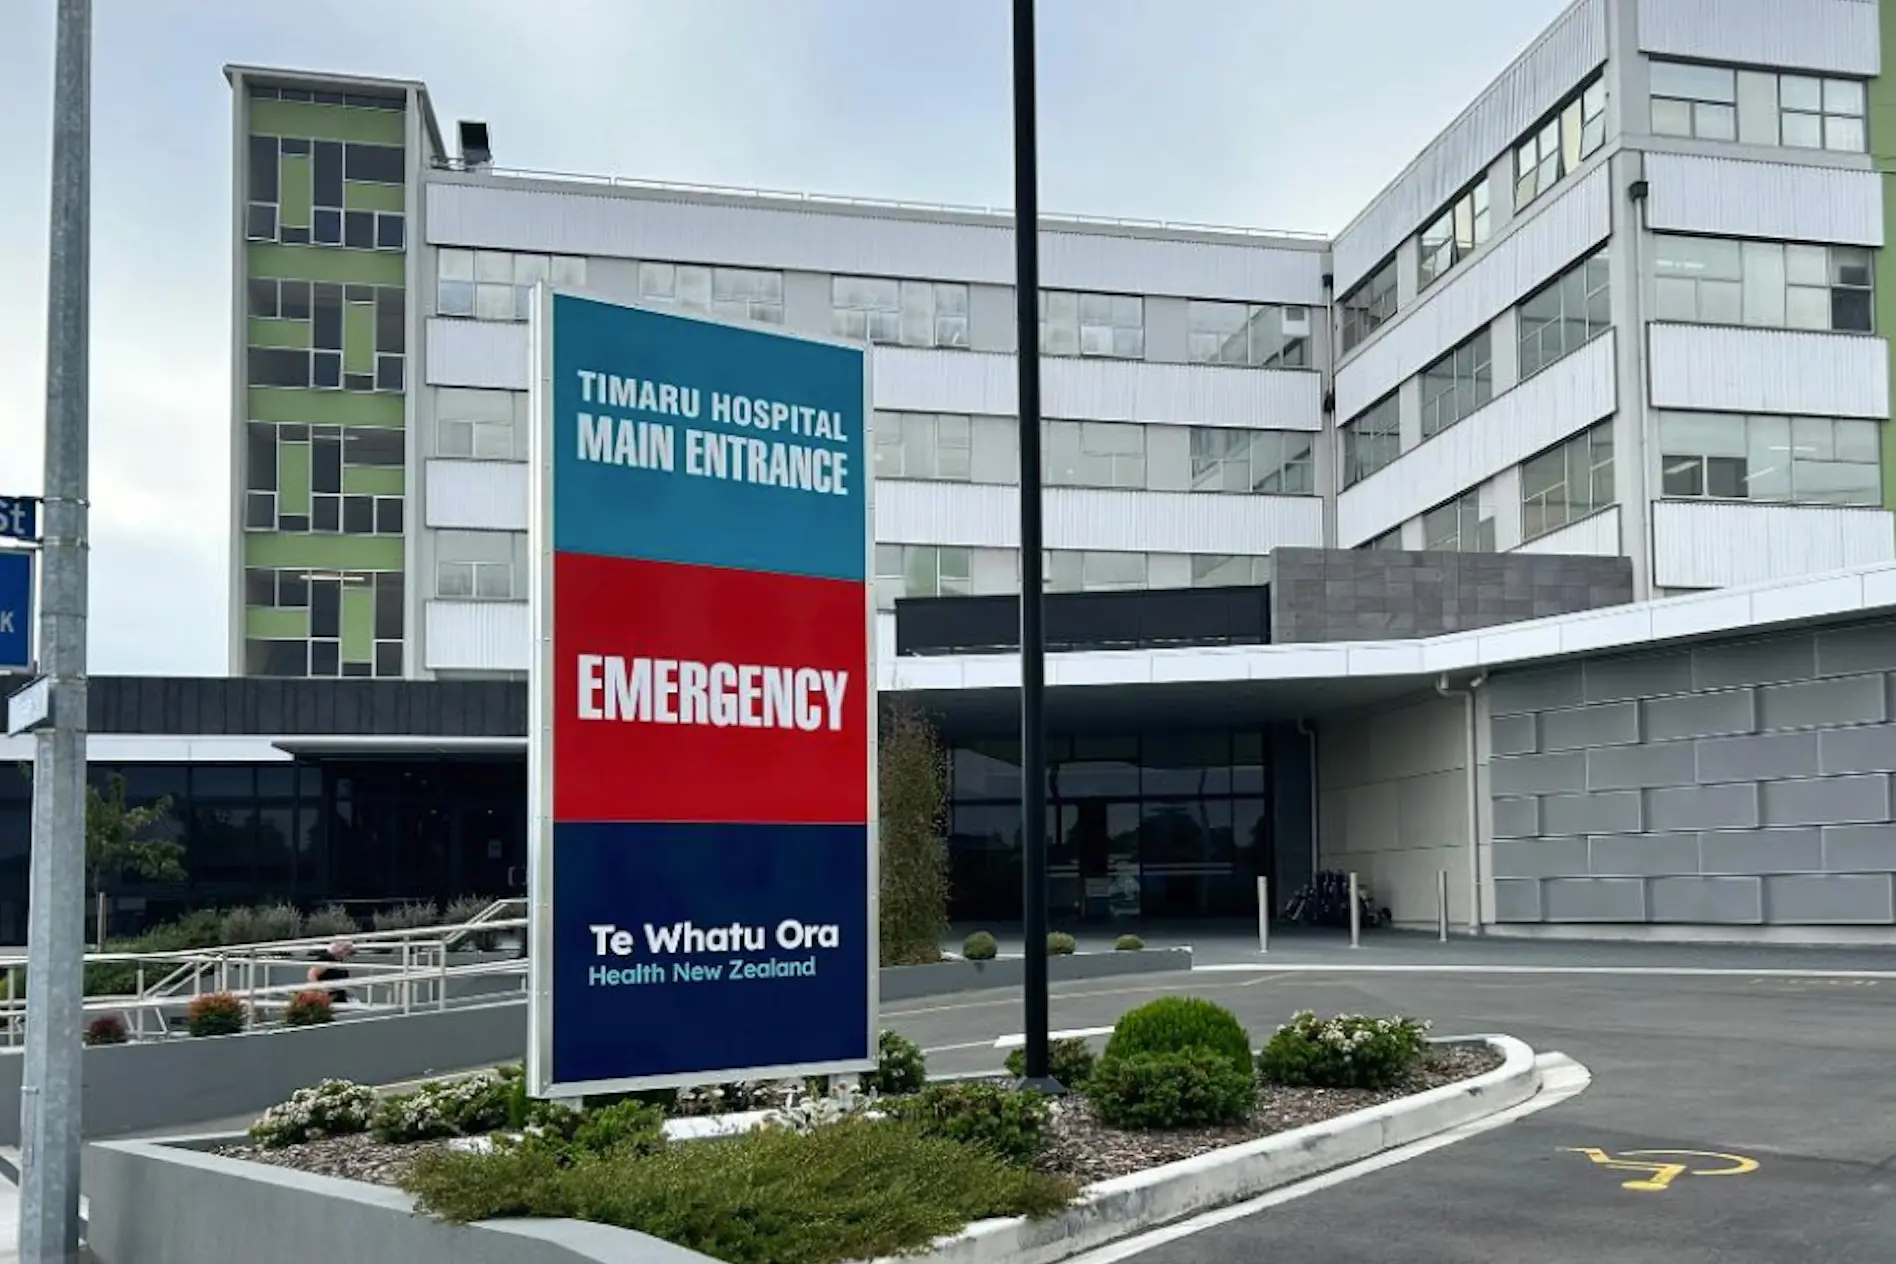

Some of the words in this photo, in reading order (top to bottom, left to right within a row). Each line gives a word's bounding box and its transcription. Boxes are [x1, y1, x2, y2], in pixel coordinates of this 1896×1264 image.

[577, 370, 699, 419] TIMARU
[712, 392, 848, 442] HOSPITAL
[577, 413, 674, 472] MAIN
[686, 429, 848, 495] ENTRANCE
[578, 654, 848, 731] EMERGENCY
[588, 963, 665, 986] Health
[673, 961, 723, 983] New
[728, 956, 816, 981] Zealand
[589, 924, 634, 956] Te
[643, 921, 765, 954] Whatu
[775, 919, 839, 949] Ora
